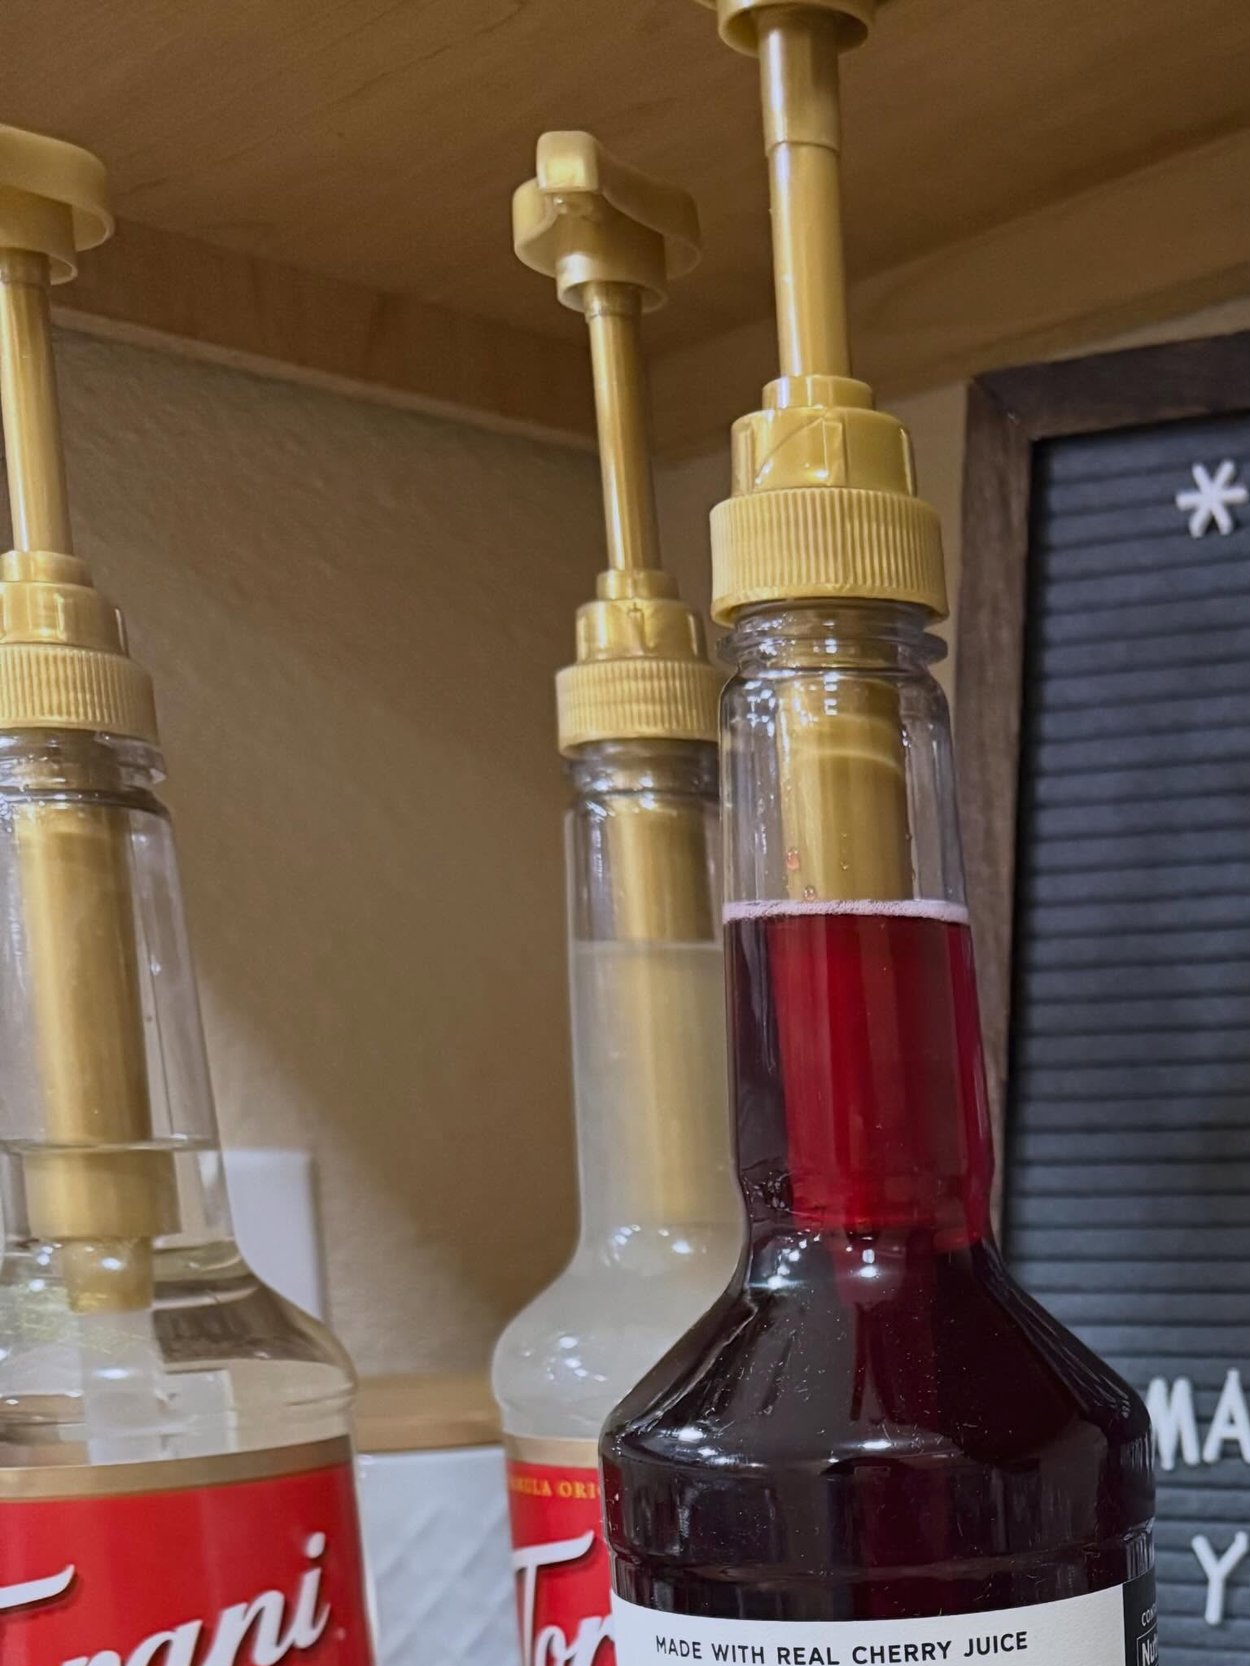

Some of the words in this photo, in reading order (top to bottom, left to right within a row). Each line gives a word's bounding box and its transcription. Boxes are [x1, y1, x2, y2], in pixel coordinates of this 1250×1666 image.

[655, 1634, 703, 1661] MADE
[711, 1642, 766, 1665] WITH
[776, 1645, 841, 1666] REAL
[851, 1640, 953, 1665] CHERRY
[963, 1630, 1029, 1657] JUICE
